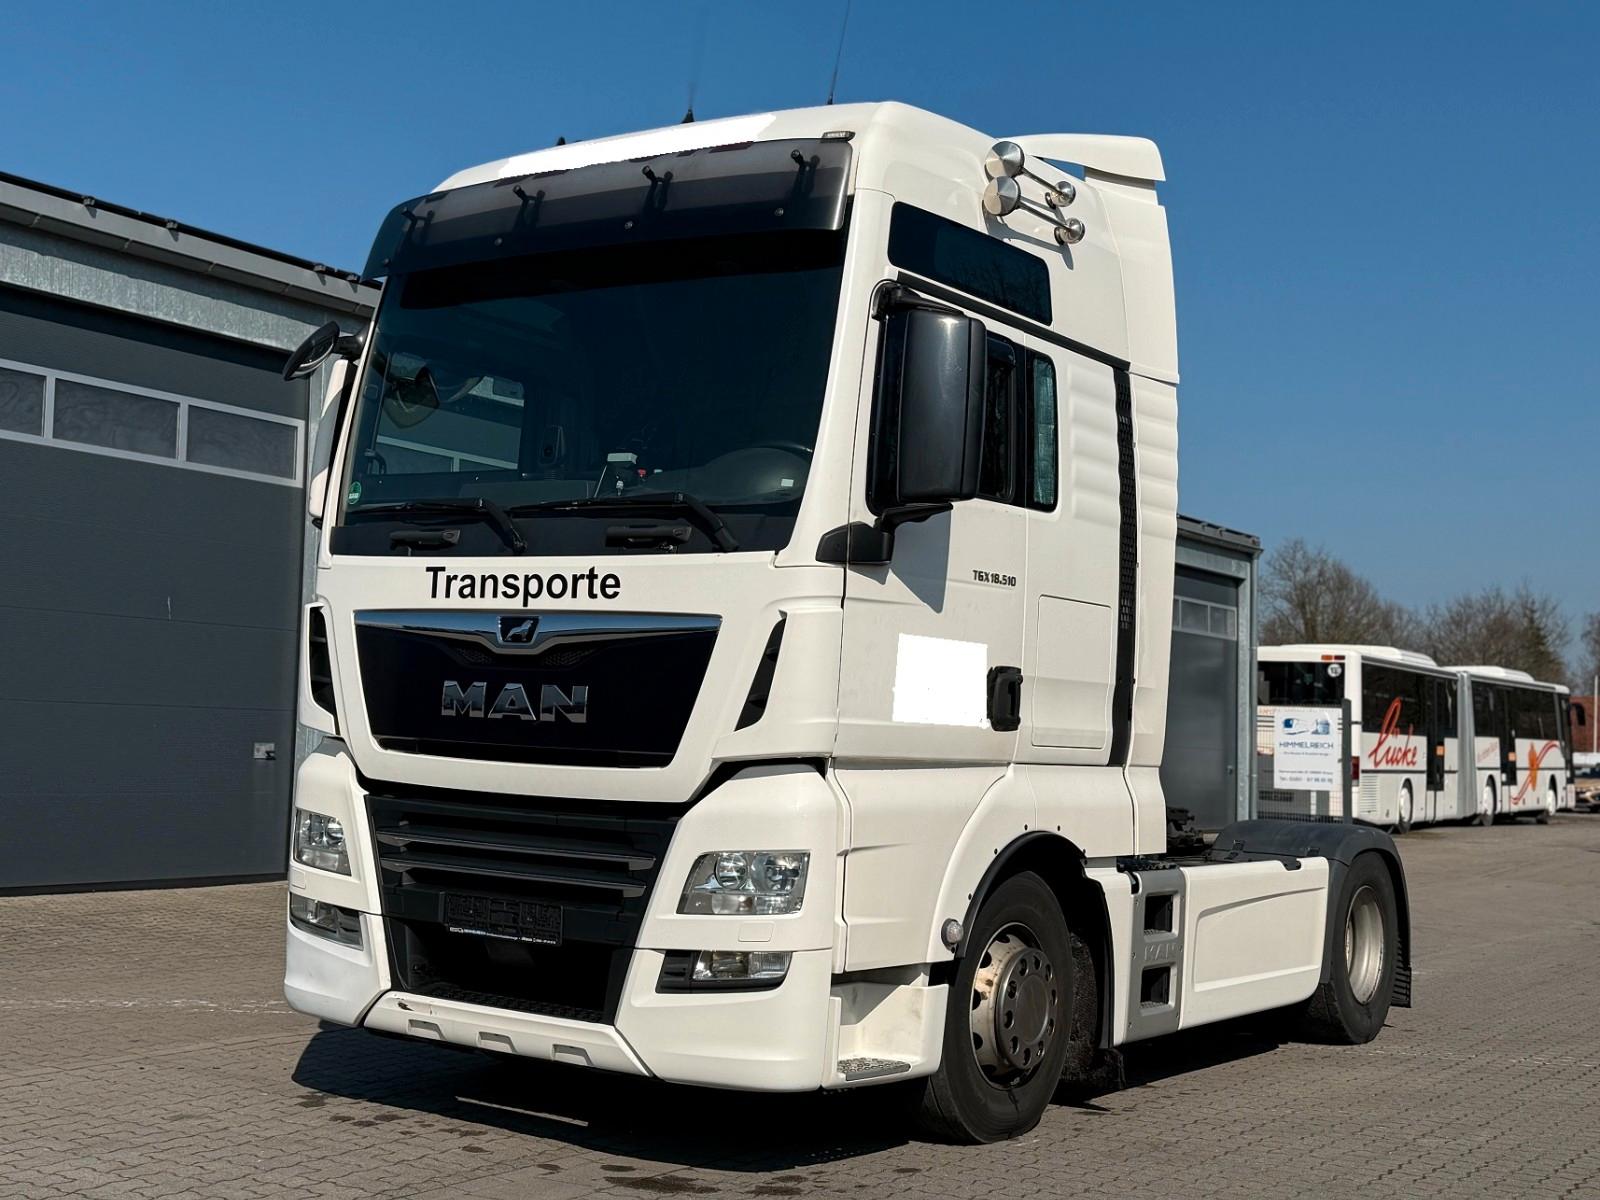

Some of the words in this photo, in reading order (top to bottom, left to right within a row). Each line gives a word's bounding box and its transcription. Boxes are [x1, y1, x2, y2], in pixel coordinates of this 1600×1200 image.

[426, 566, 621, 607] Transporte
[441, 680, 589, 723] MAN
[1279, 741, 1333, 749] HIMMELREICH
